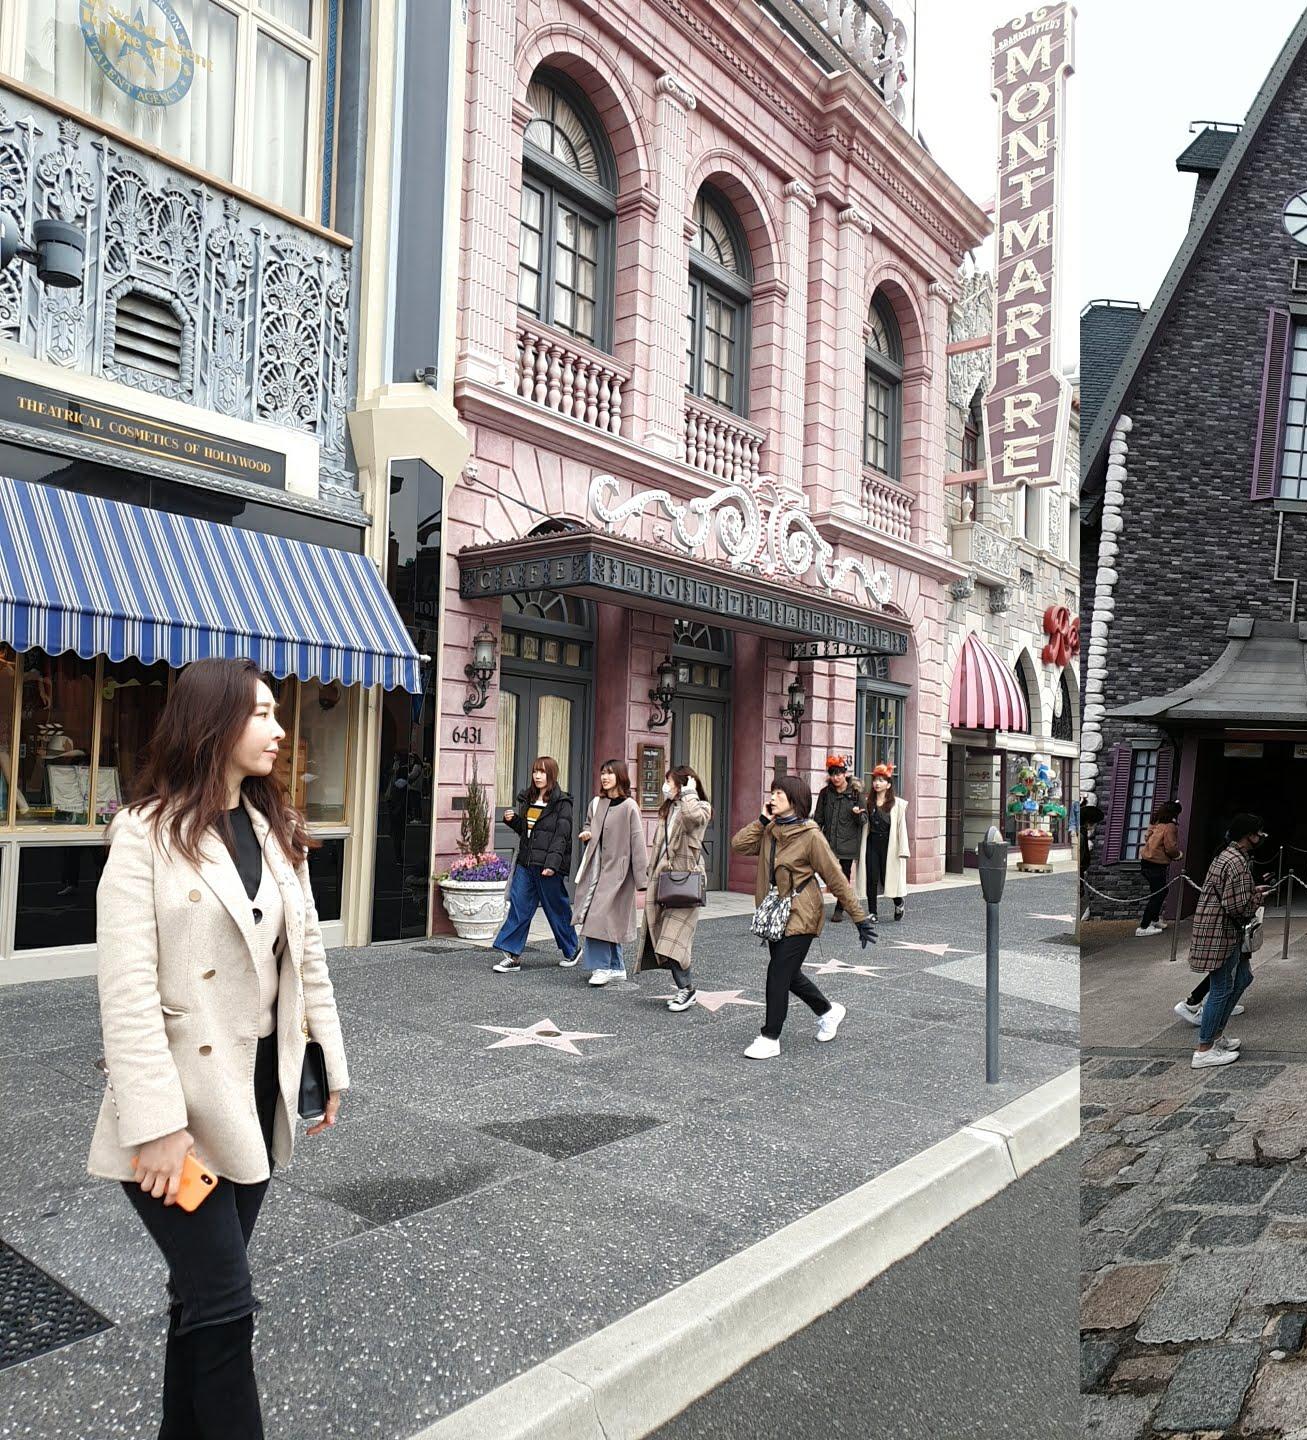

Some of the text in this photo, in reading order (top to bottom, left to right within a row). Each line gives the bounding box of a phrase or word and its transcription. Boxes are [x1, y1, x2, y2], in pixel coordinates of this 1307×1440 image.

[90, 42, 182, 105] TALENT AGENCY
[1001, 34, 1053, 478] MONTMARTRE
[17, 396, 272, 474] THEATRICAL COSMETICS OF HOLLYWOOD
[480, 562, 566, 590] CAFE
[626, 567, 890, 646] MONTMARTRE
[452, 726, 482, 745] 6431
